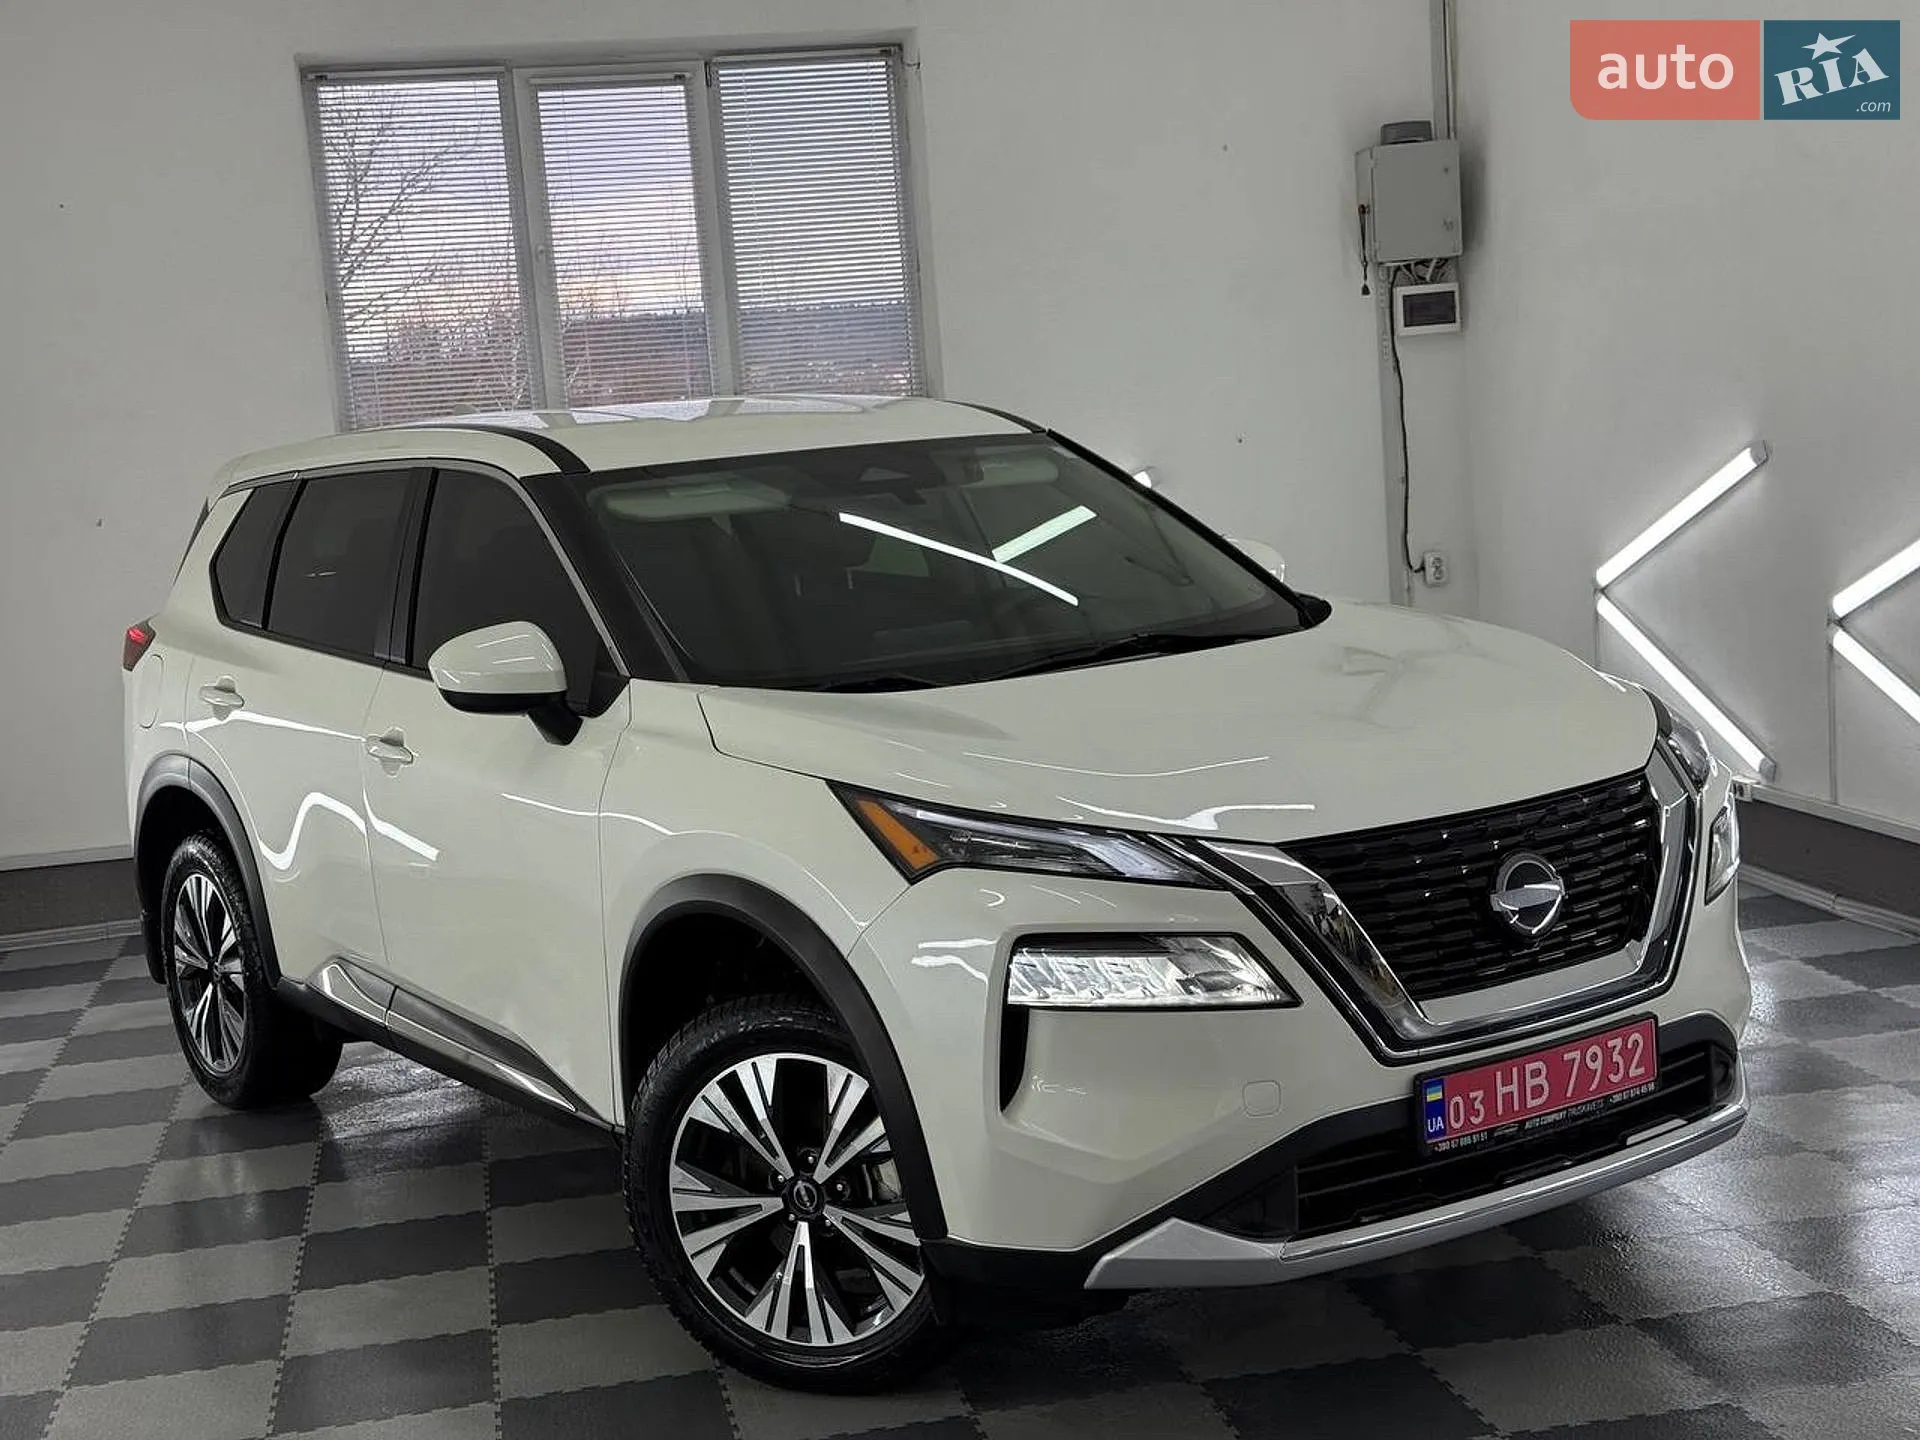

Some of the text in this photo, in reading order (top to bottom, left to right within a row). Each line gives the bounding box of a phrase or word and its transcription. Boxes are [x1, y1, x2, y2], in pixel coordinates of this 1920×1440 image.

[1449, 1032, 1645, 1129] 03 HB 7932
[1427, 1116, 1444, 1132] UA
